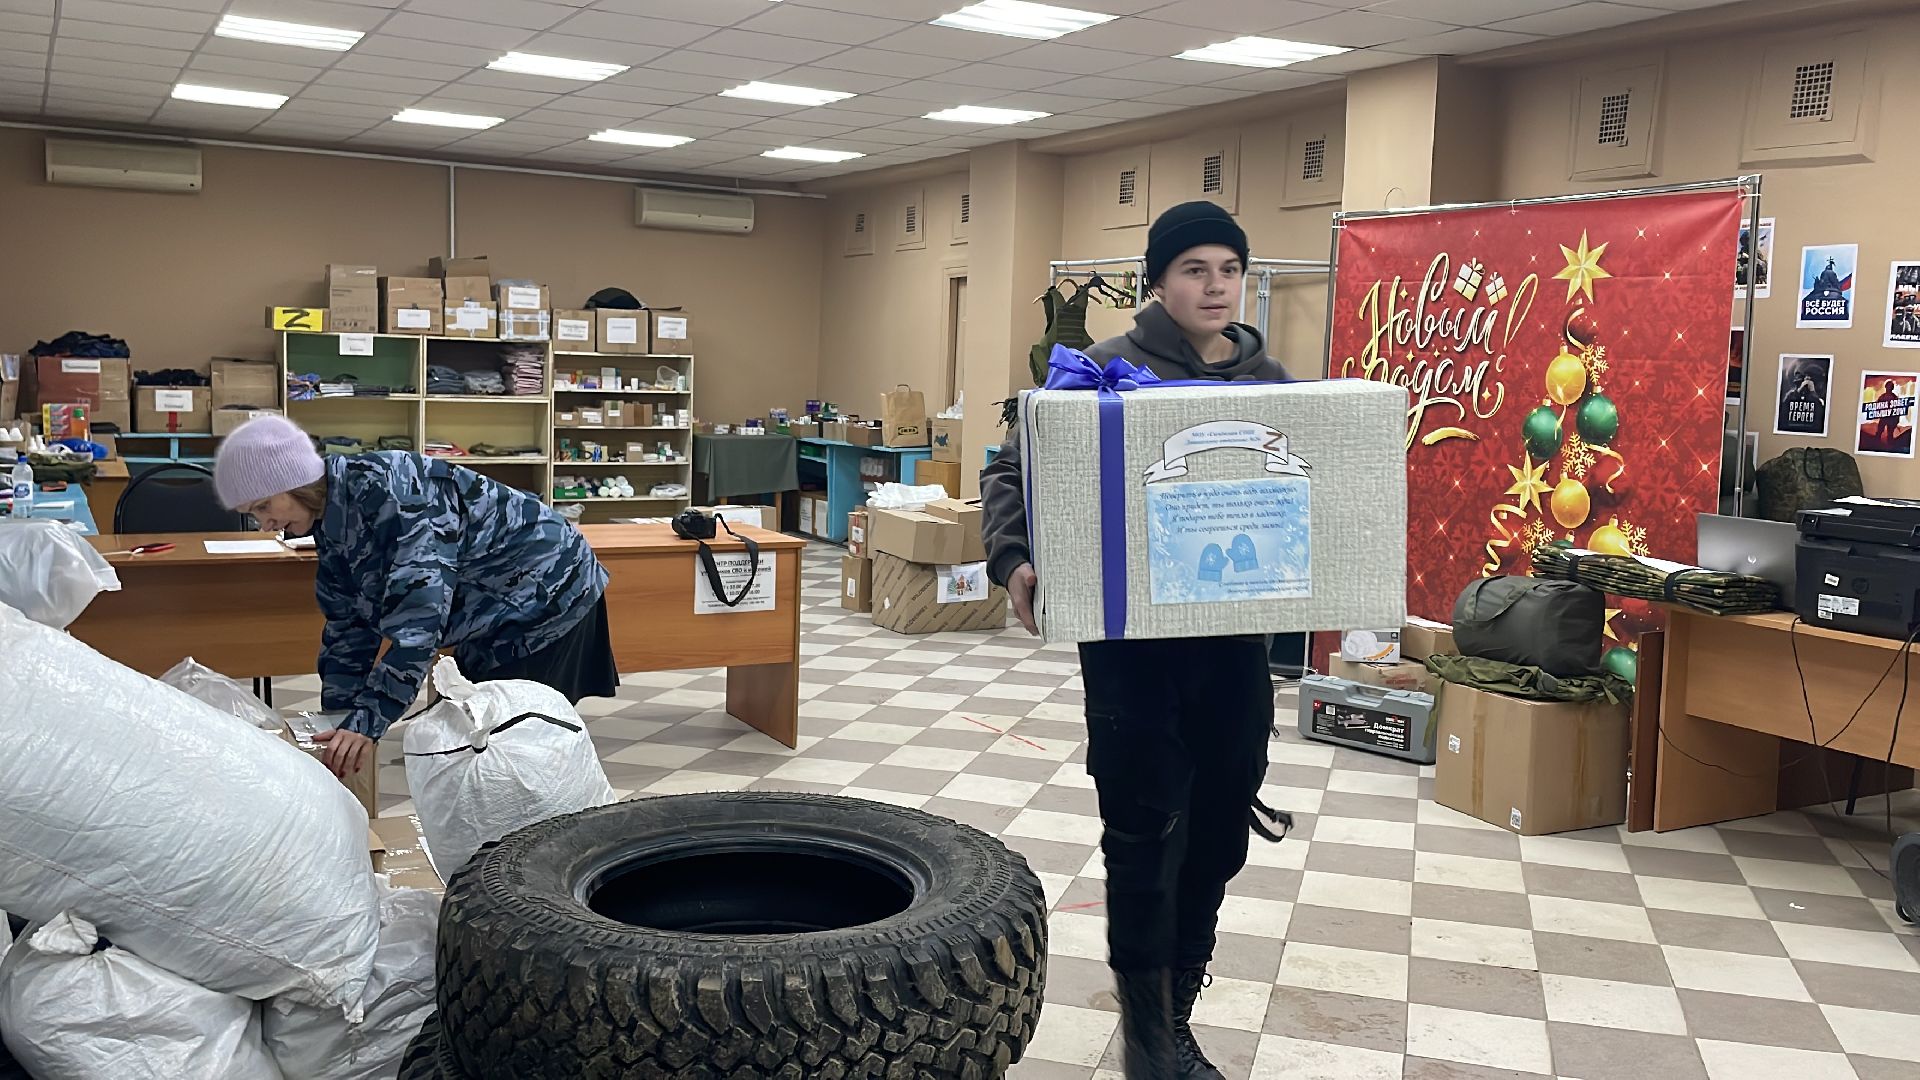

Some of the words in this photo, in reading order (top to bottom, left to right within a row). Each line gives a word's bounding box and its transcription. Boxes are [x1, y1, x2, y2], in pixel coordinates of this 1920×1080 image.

[1806, 299, 1819, 307] ВСЁ
[1805, 307, 1845, 315] РОССИЯ
[282, 309, 311, 329] Z
[1789, 401, 1815, 411] ВРЕМЯ
[1865, 401, 1889, 411] РОДИНА
[1788, 411, 1815, 422] ГЕРОЕВ
[1263, 431, 1283, 451] Z
[728, 559, 764, 567] ПОДДЕРИ
[1373, 722, 1404, 734] Домкрат
